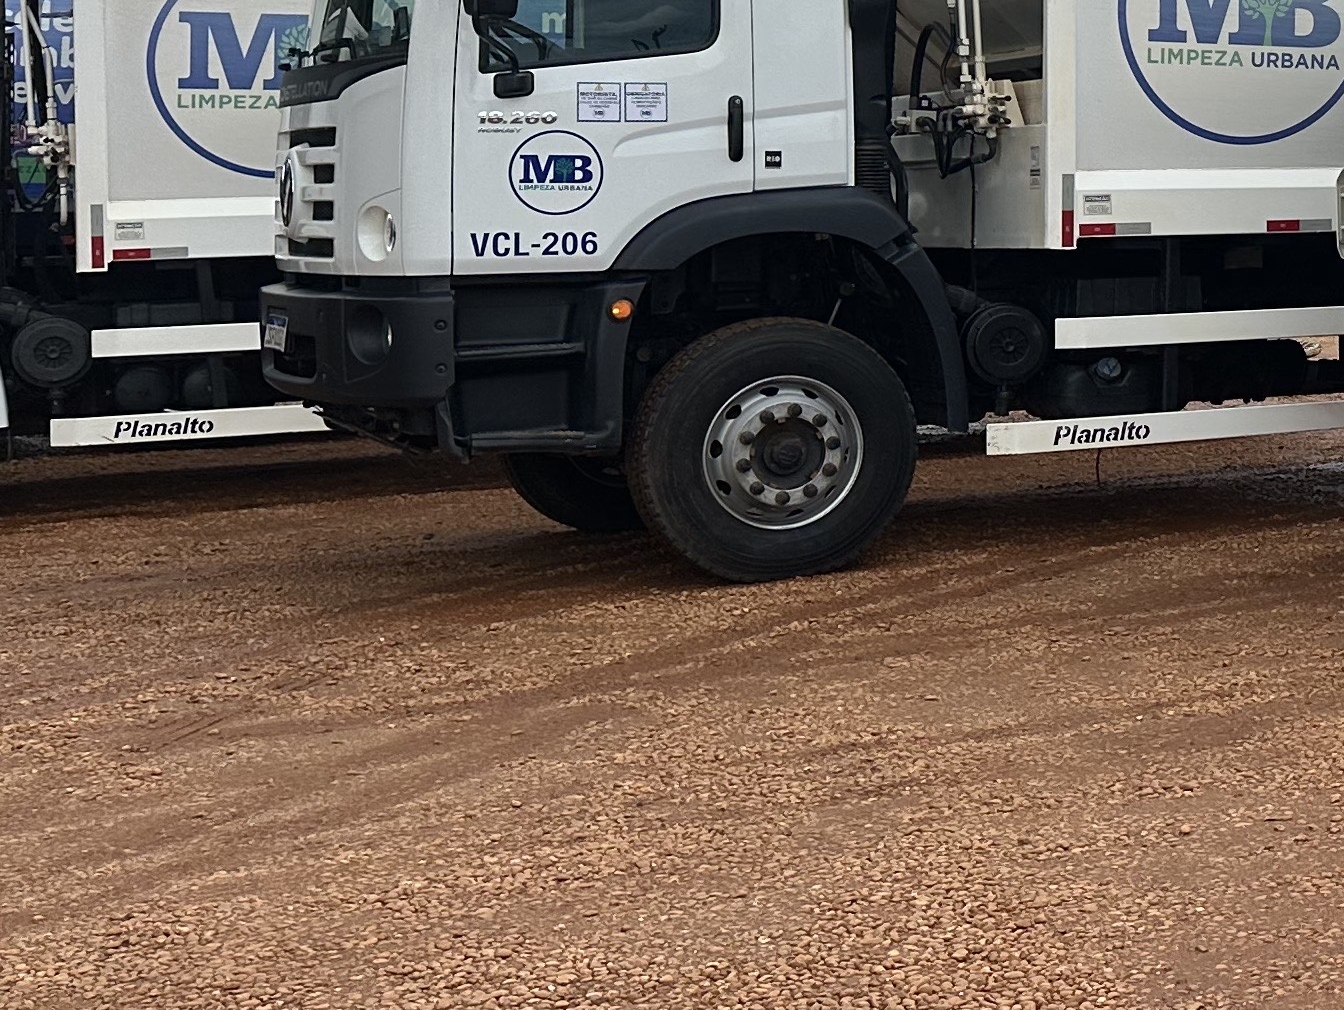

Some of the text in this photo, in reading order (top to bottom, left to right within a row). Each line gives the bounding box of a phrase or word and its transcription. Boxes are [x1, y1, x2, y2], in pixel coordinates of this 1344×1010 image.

[1147, 48, 1340, 70] LIMPEZA URBANA
[177, 94, 281, 109] LIMPEZA
[519, 154, 594, 184] MB
[470, 231, 598, 257] VCL-206
[114, 418, 214, 439] Planalto
[1053, 421, 1151, 446] Planalto
